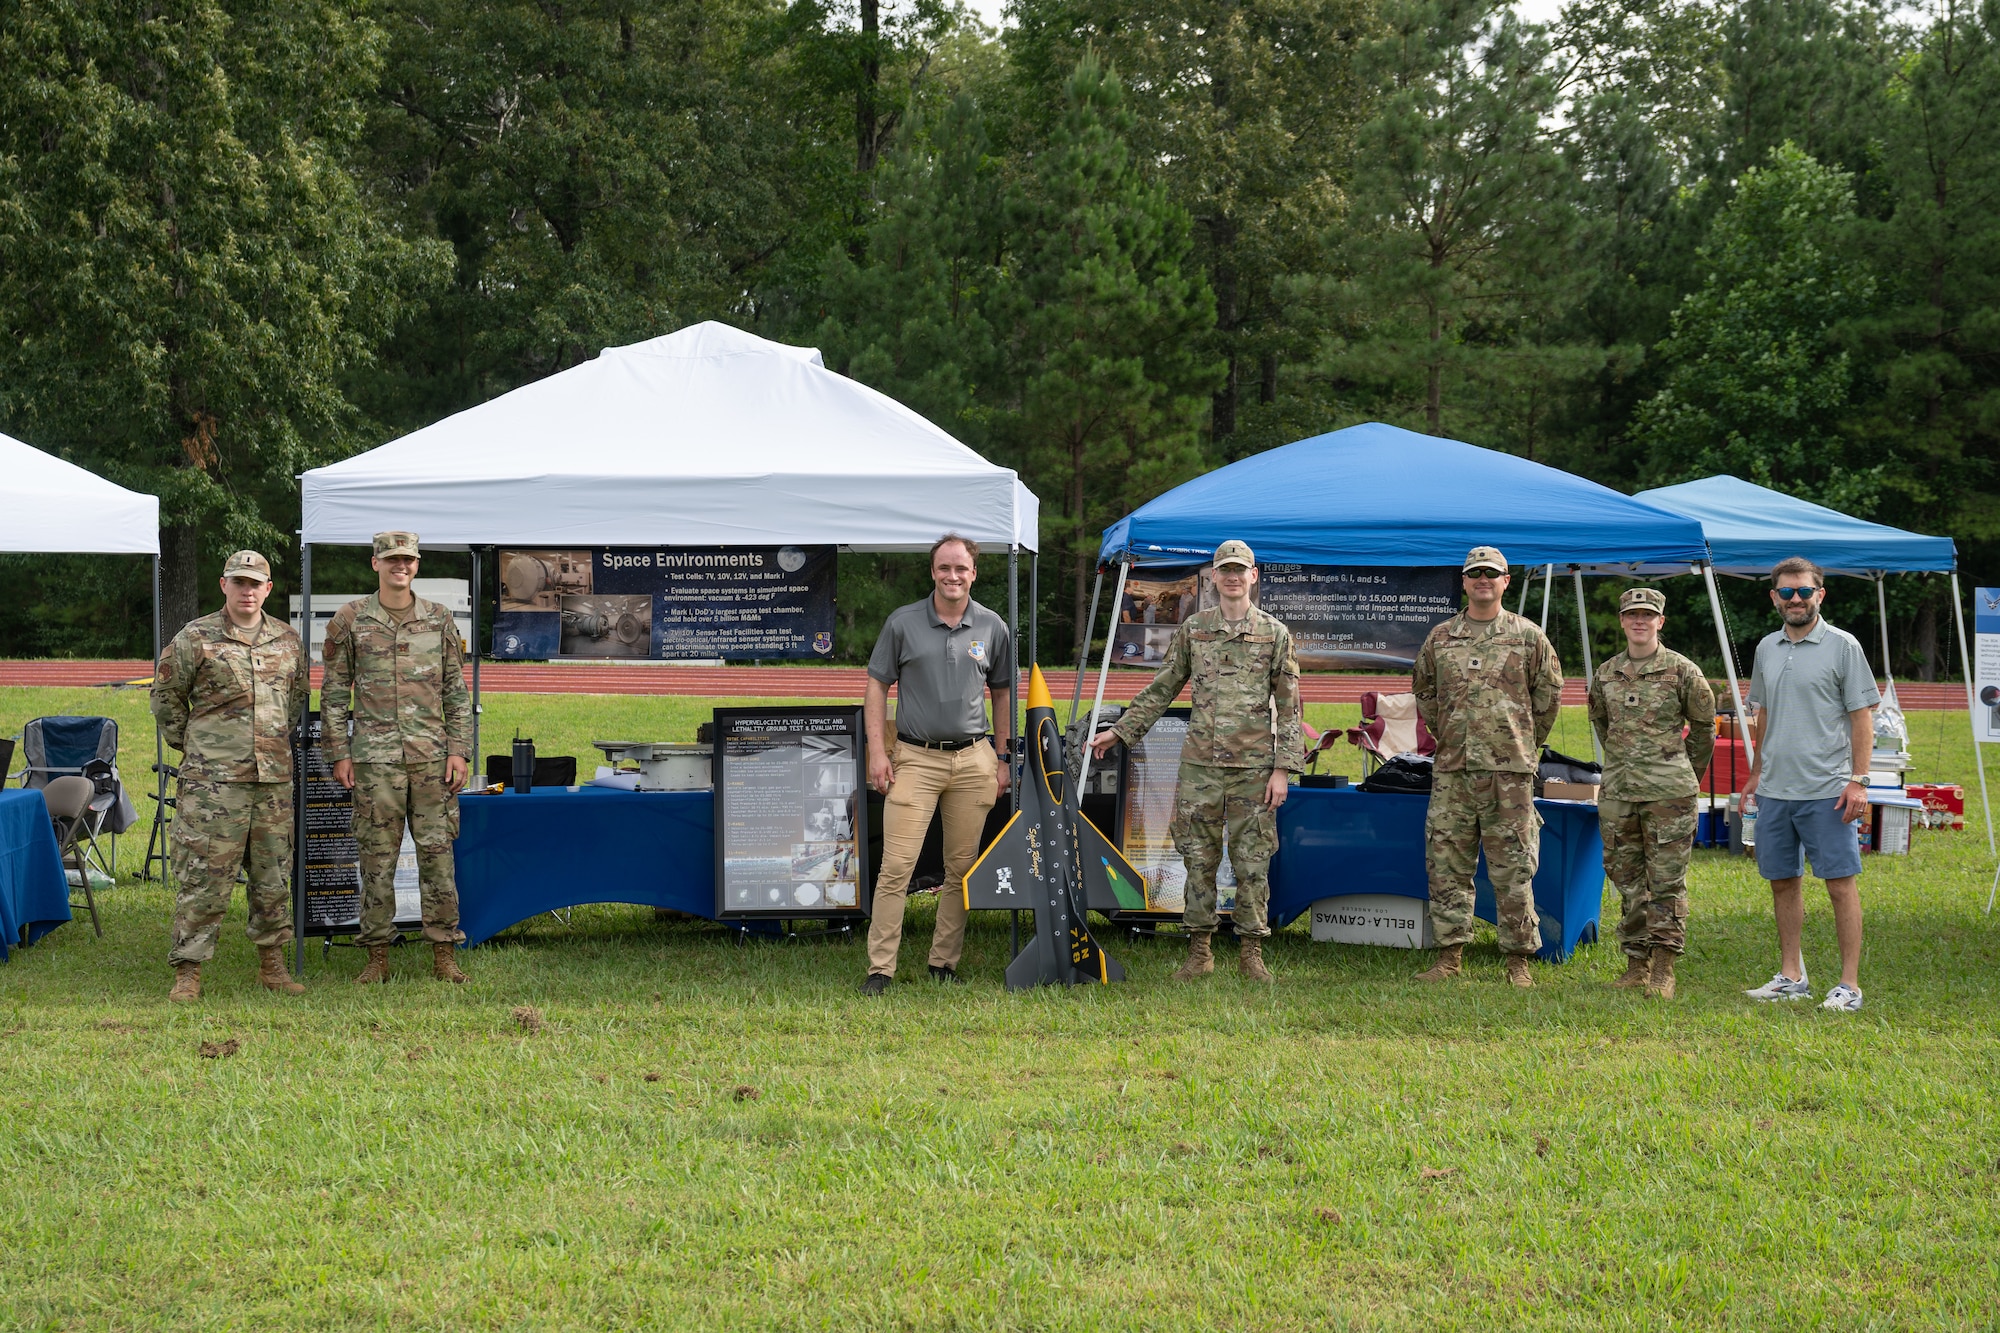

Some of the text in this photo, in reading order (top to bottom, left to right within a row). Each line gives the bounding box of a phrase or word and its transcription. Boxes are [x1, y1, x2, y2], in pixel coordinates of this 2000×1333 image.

[603, 552, 764, 570] Space Environments
[1264, 563, 1302, 572] Ranges
[1311, 574, 1339, 583] Ranges
[1350, 575, 1354, 583] I,
[721, 588, 748, 596] systems
[757, 585, 788, 594] simulated
[1308, 594, 1347, 602] projectiles
[1369, 594, 1397, 603] 15,000
[1428, 596, 1450, 605] study
[715, 608, 737, 616] largest
[1261, 604, 1278, 612] high
[1280, 604, 1303, 612] speed
[1305, 604, 1352, 612] aerodynamic
[1372, 604, 1398, 612] impact
[1400, 604, 1458, 614] characteristics
[1396, 614, 1430, 623] minutes)
[663, 636, 738, 644] electro-optical/infrared
[1326, 632, 1354, 641] Largest
[755, 642, 784, 650] standing
[1302, 642, 1336, 651] Light-Gas
[1028, 828, 1038, 849] Space
[1316, 912, 1415, 930] BELLA+CANVAS
[1070, 928, 1081, 964] 718
[1080, 932, 1090, 960] TN
